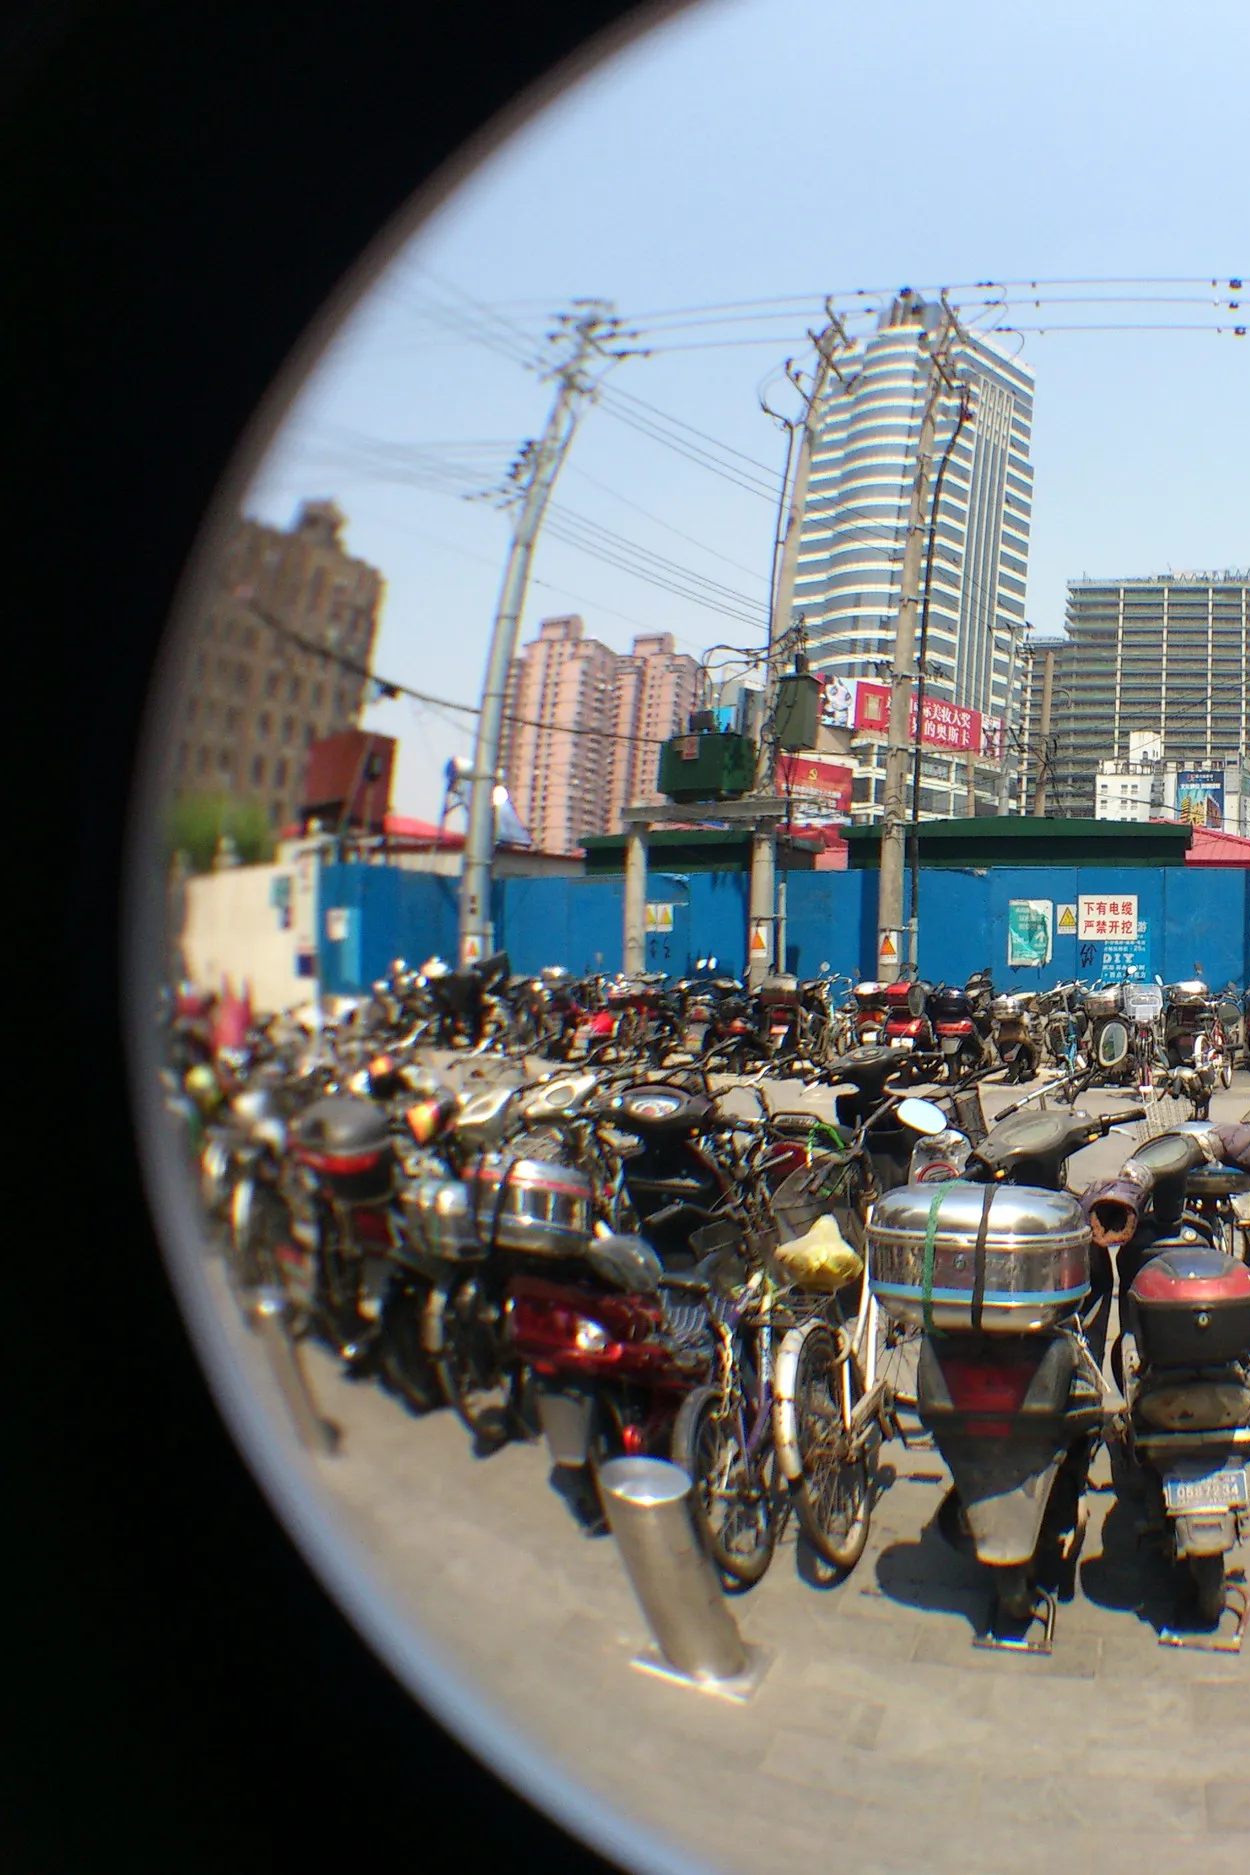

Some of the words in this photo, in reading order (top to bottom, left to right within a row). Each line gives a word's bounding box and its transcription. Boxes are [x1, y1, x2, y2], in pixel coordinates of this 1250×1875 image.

[1083, 901, 1133, 916] 下有电缆
[1083, 920, 1133, 934] 严禁开挖
[1103, 953, 1134, 964] DIY
